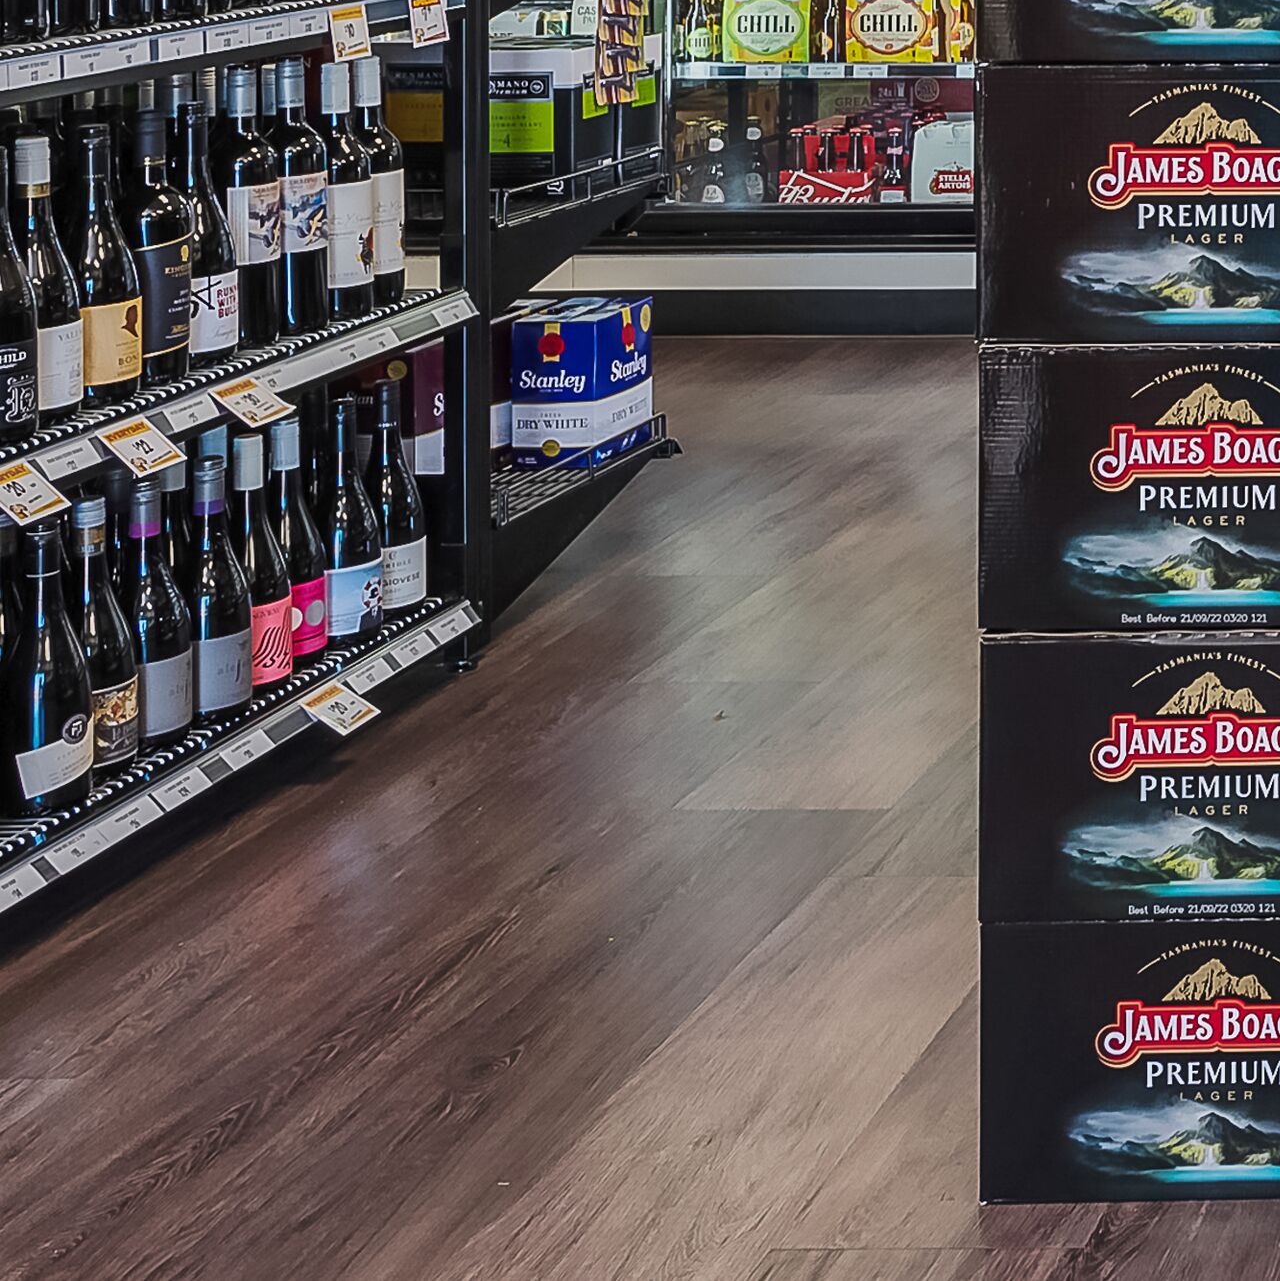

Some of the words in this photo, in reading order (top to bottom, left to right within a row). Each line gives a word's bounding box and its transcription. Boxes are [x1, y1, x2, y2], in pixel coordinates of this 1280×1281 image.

[736, 13, 795, 34] CHILL
[859, 12, 918, 34] CHILL
[938, 173, 971, 182] STELLA
[1096, 150, 1203, 196] JAMES
[938, 181, 971, 190] ARTOIS
[1137, 203, 1276, 230] PREMIUM
[1171, 233, 1244, 245] LAGER
[611, 352, 647, 382] Stanley
[1154, 364, 1219, 385] TASMANIA'S
[1224, 365, 1264, 384] FINEST
[520, 370, 586, 393] Stanley
[105, 422, 146, 442] EVERYDAY
[517, 420, 540, 429] DRY
[543, 418, 588, 428] WHITE
[1097, 431, 1204, 478] JAMES
[1139, 484, 1277, 511] PREMIUM
[1173, 515, 1246, 527] LAGER
[1122, 613, 1142, 624] Best
[1147, 613, 1177, 624] Before
[1180, 613, 1222, 625] 21/09/22
[1251, 613, 1267, 624] 121
[1098, 720, 1207, 769] JAMES
[1140, 774, 1280, 802] PREMIUM
[1174, 804, 1249, 816] LAGER
[1103, 1010, 1213, 1056] JAMES
[1180, 1091, 1253, 1102] LAGER
